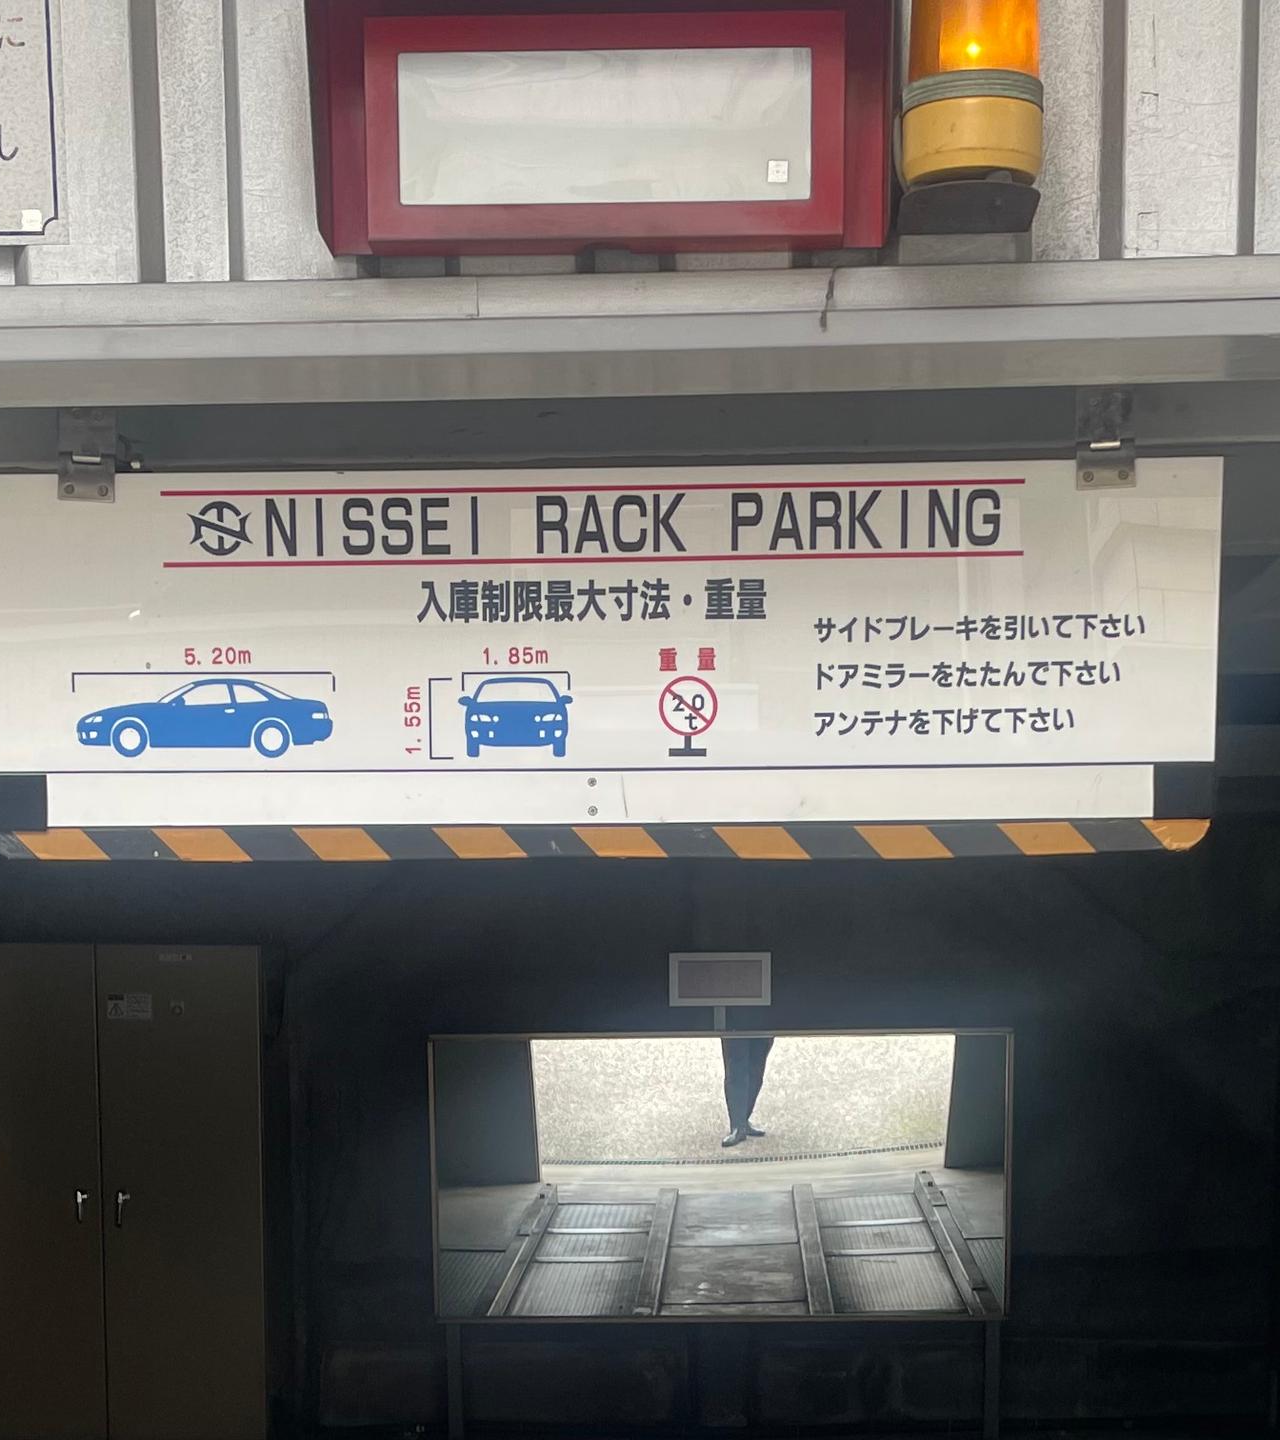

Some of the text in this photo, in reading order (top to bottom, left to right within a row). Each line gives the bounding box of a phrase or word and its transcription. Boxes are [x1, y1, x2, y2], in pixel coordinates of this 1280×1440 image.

[264, 489, 1002, 558] NISSEI RACK PARKING
[417, 577, 768, 623] 入庫制限最大寸法・重量
[813, 613, 1146, 643] サイドブレーキを引いて下さい
[184, 647, 252, 666] 5.20m
[482, 646, 549, 666] 1.85m
[816, 660, 1122, 690] ドアミラーをたたんで下さい
[404, 685, 422, 754] 1.55m
[814, 707, 1075, 737] アンテナを下げて下さい
